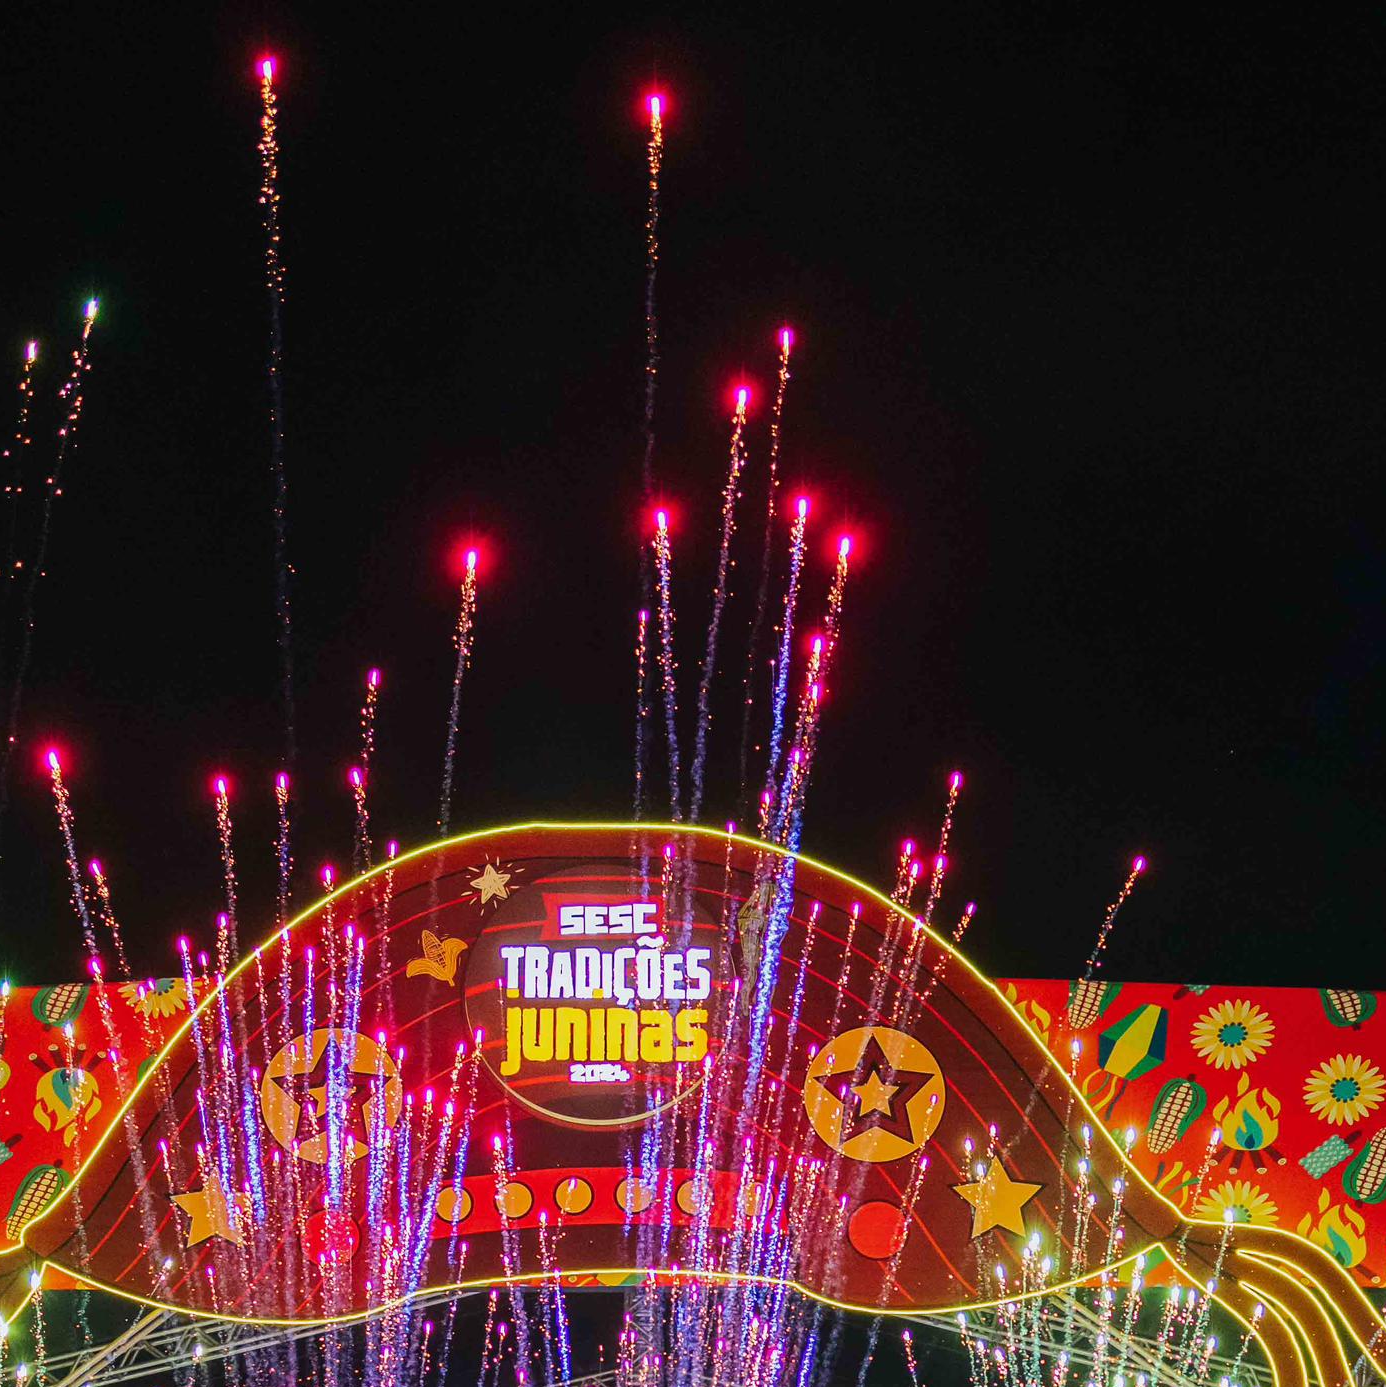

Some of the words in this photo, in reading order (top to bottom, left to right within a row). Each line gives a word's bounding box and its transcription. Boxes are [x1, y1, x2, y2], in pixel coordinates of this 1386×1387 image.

[560, 903, 657, 935] SESC
[500, 936, 711, 1005] TRADIÇÕES
[569, 1063, 630, 1083] 2024
